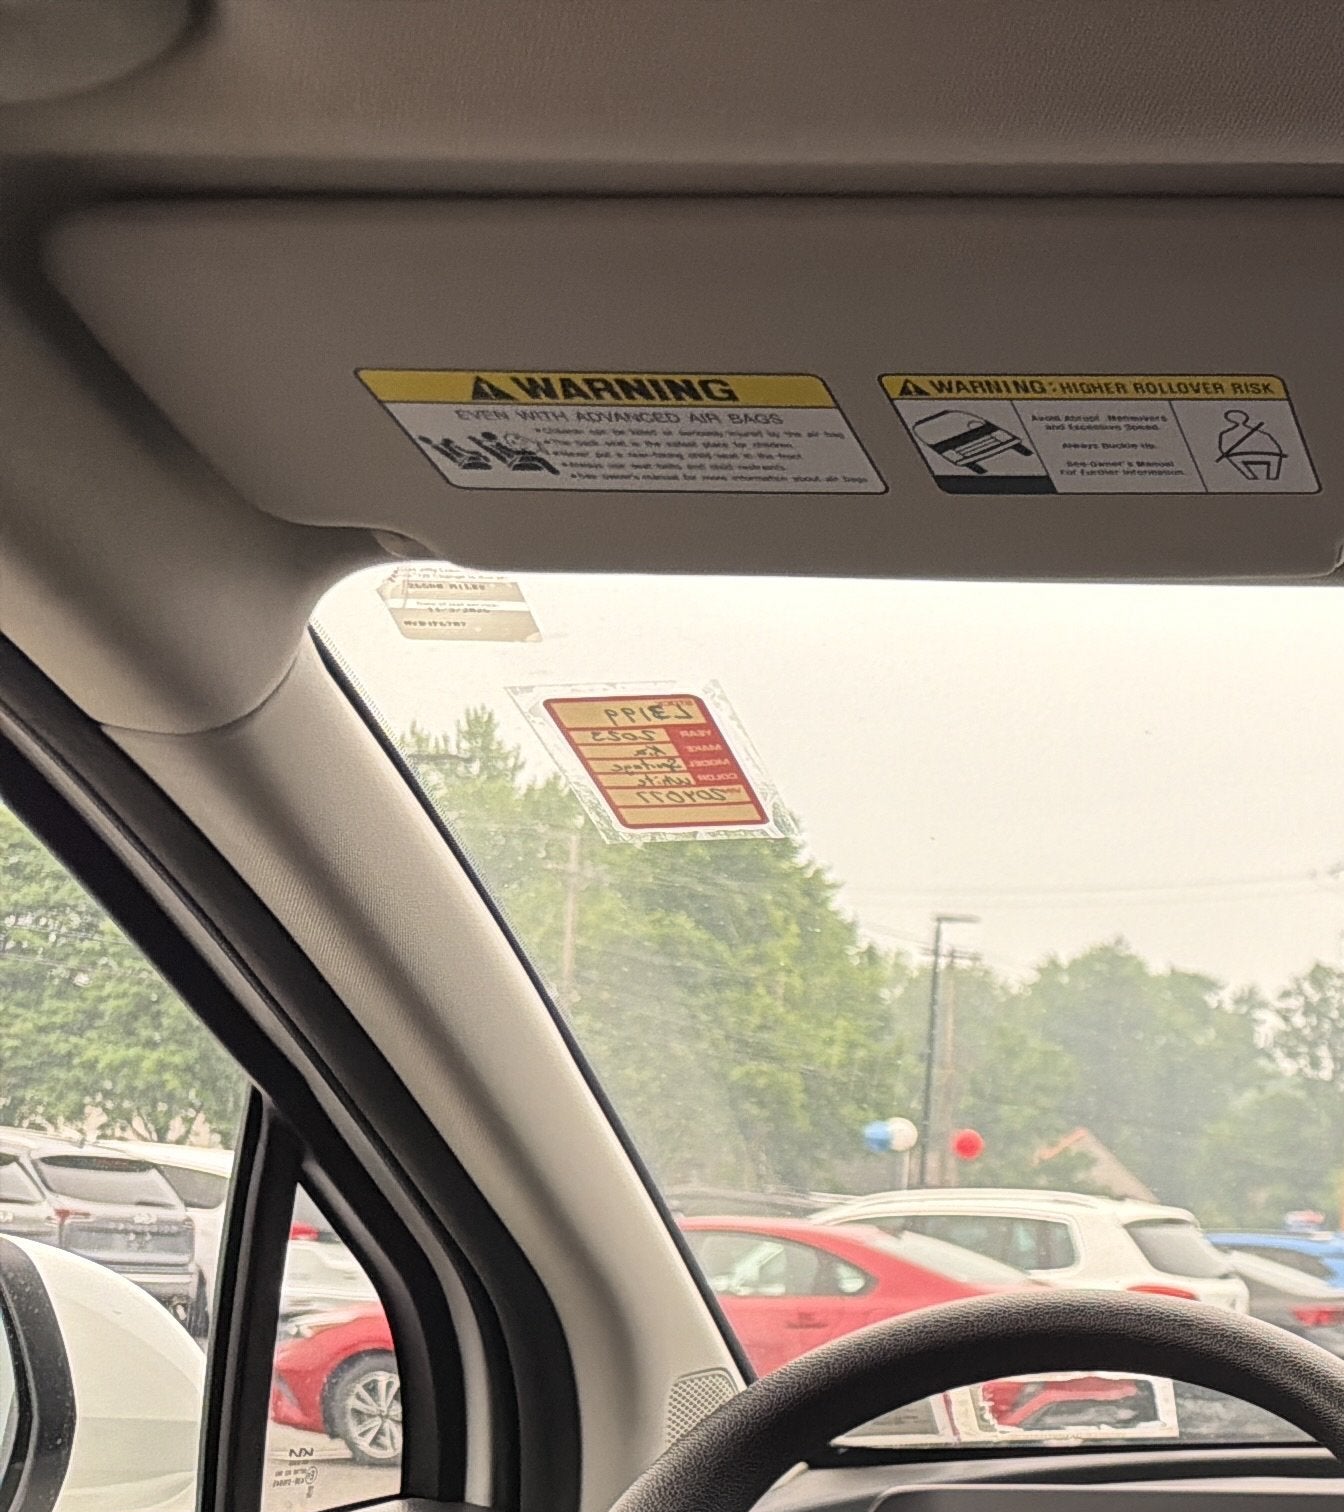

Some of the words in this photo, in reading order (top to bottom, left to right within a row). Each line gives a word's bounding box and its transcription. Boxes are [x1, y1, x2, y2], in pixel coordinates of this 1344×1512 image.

[510, 376, 740, 402] WARNING
[1060, 381, 1128, 395] HIGHER
[1132, 381, 1225, 395] ROLLOVER
[1230, 382, 1275, 396] RISK
[455, 409, 510, 422] EVEN
[515, 410, 570, 423] WITH
[575, 411, 681, 424] ADVANCED
[688, 413, 721, 425] AIR
[729, 413, 784, 425] BAGS
